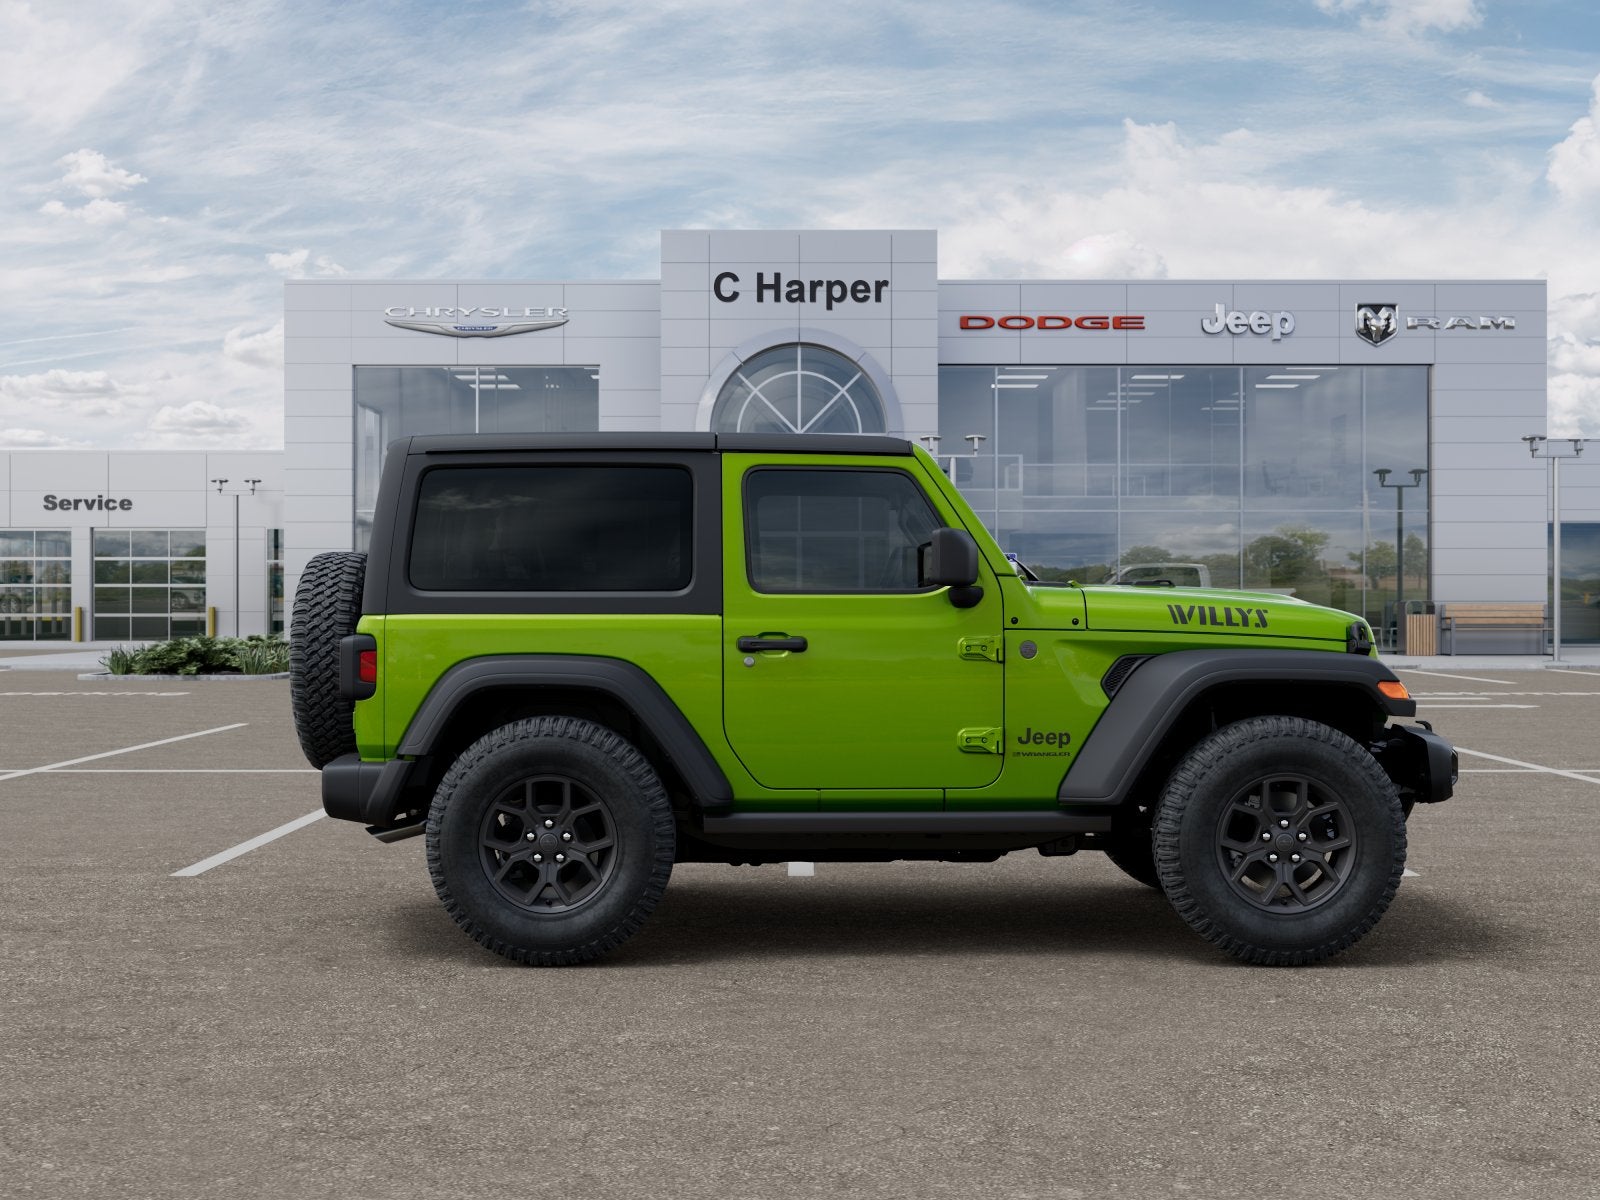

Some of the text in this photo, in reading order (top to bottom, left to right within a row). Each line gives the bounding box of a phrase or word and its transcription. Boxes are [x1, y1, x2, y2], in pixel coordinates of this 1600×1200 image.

[713, 271, 890, 311] C Harper
[384, 306, 570, 317] CHRYSLER
[959, 315, 1146, 330] DODGE
[1201, 303, 1295, 341] Jeep
[1406, 316, 1515, 330] RAM
[43, 494, 133, 511] Service
[1167, 604, 1269, 628] WILLYS
[1017, 727, 1071, 748] Jeep
